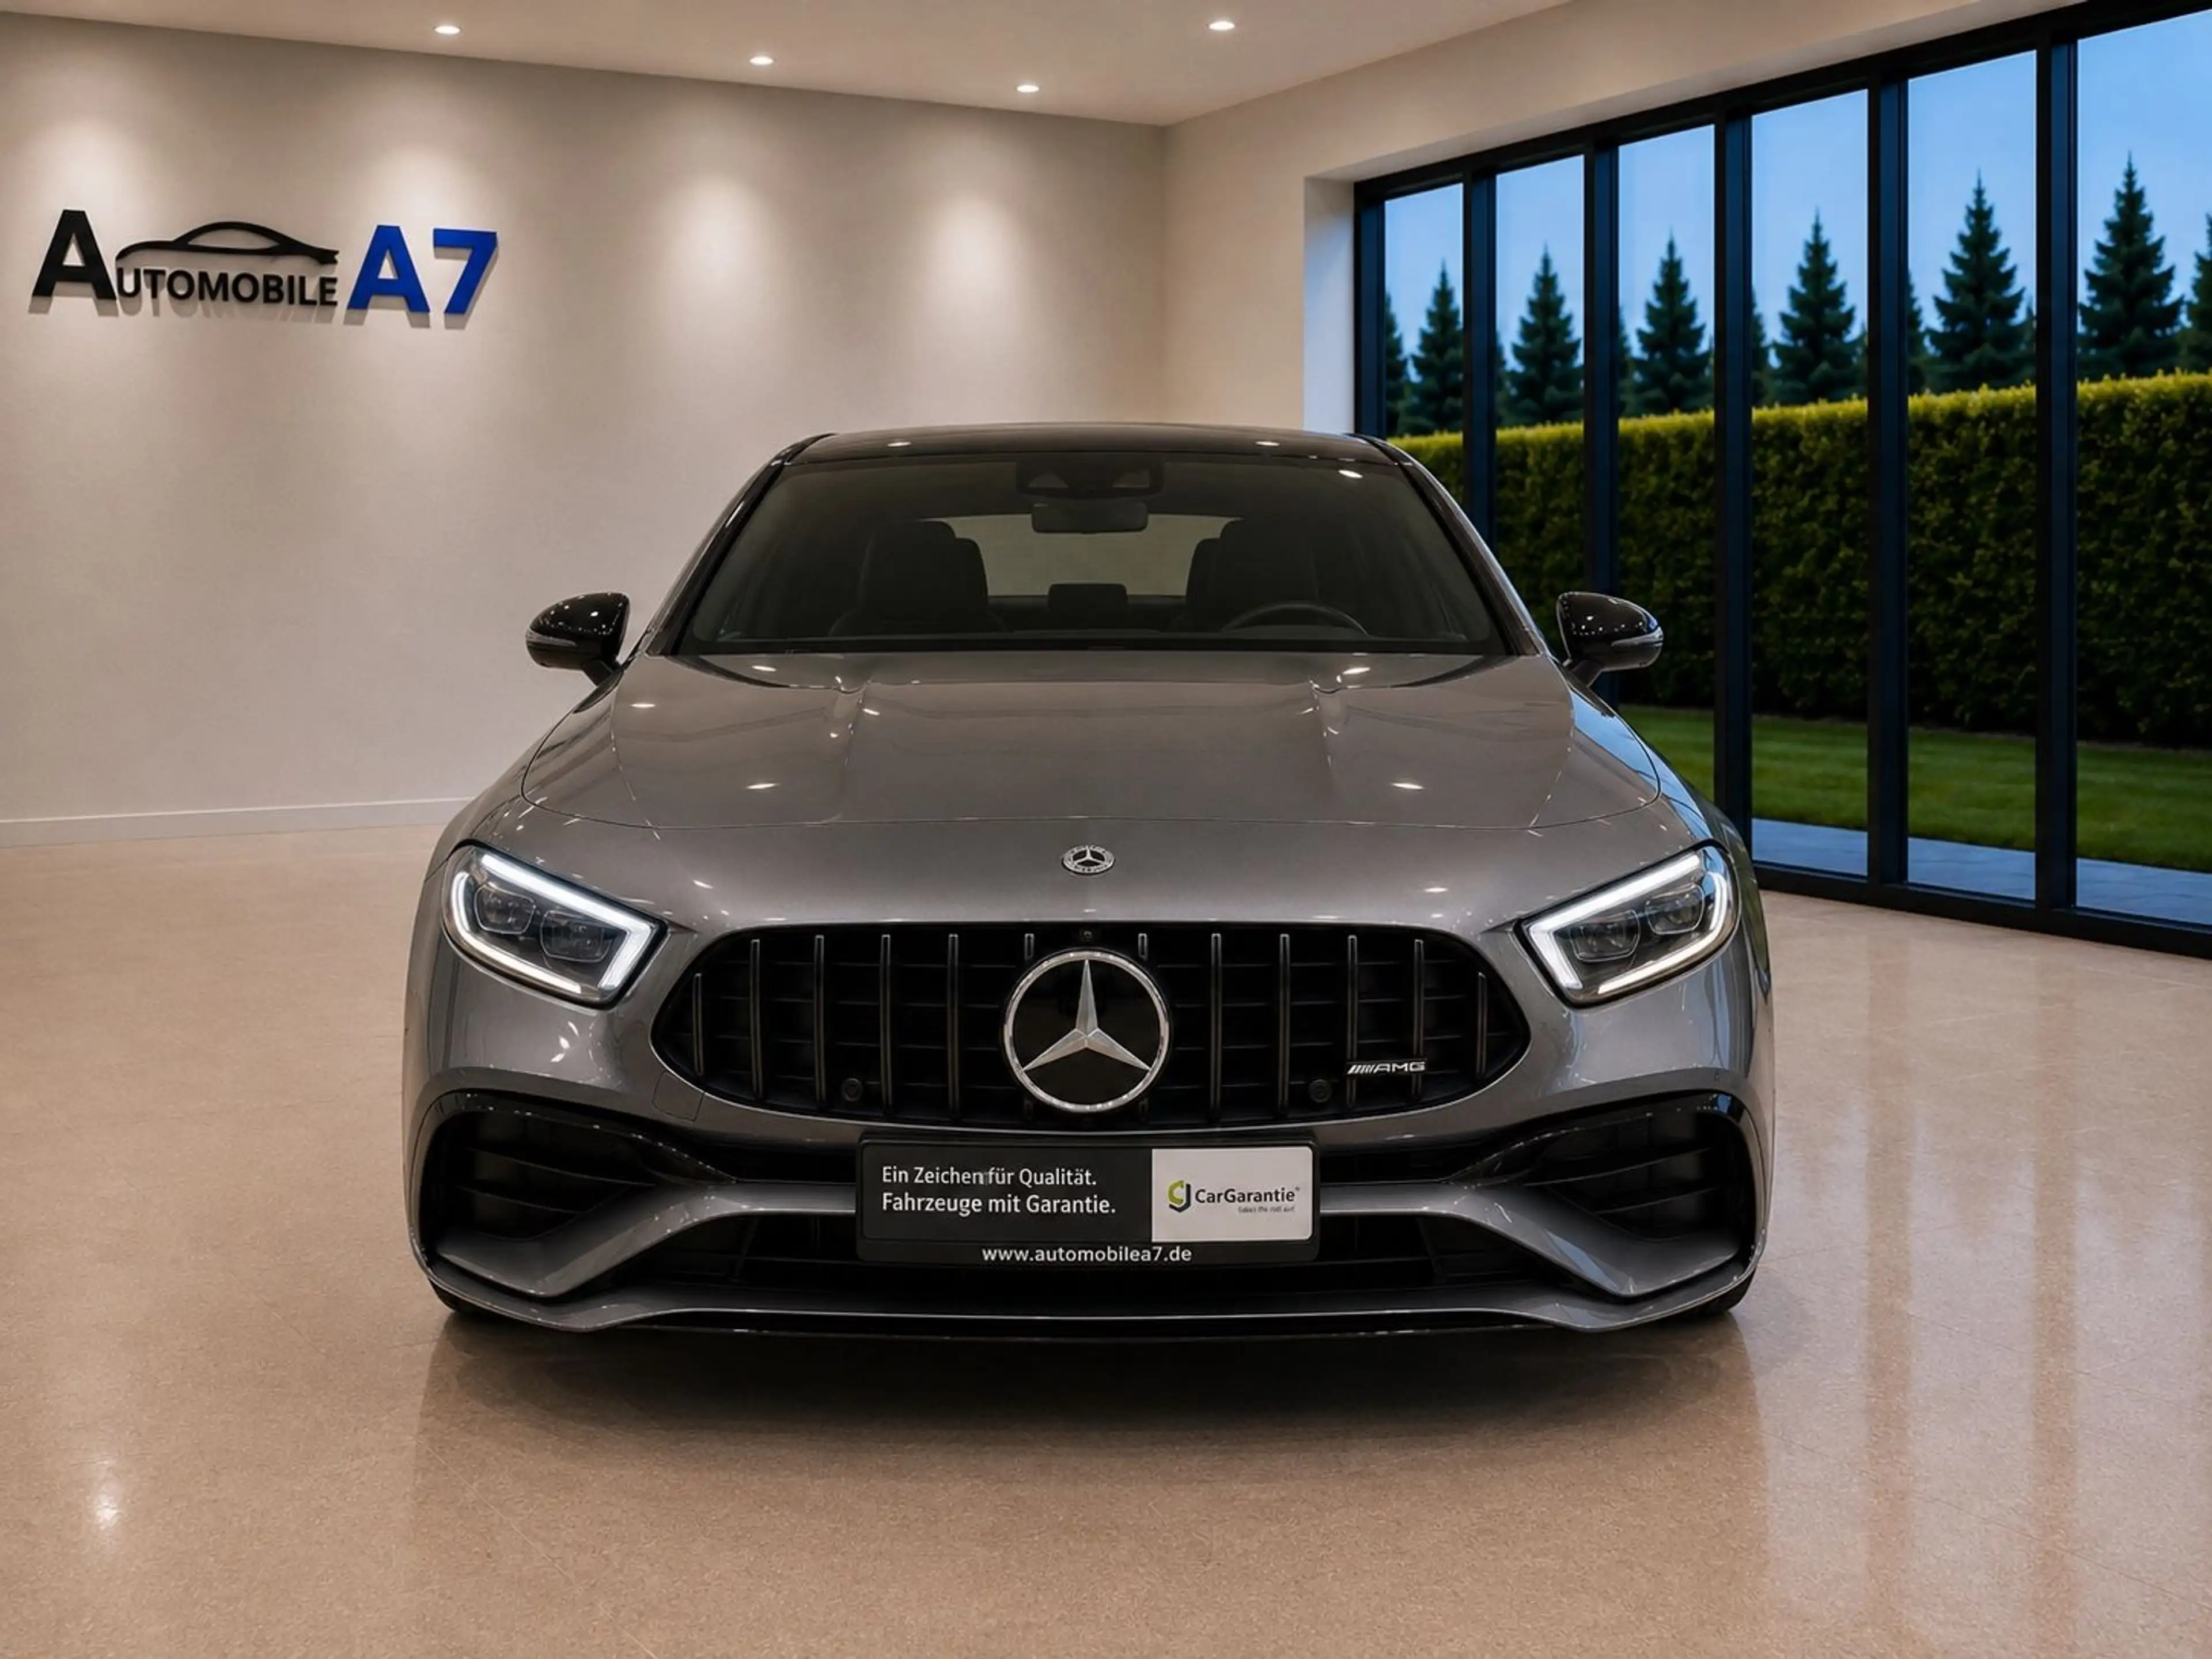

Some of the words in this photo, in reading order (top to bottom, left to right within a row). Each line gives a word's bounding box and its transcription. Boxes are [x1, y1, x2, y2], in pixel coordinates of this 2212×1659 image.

[346, 224, 498, 315] A7
[1373, 1061, 1426, 1074] AMG
[882, 1166, 908, 1183] Ein
[914, 1166, 984, 1185] Zeichen
[987, 1167, 1014, 1185] für
[1018, 1168, 1097, 1188] Qualität.
[882, 1192, 982, 1217] Fahrzeuge
[988, 1194, 1021, 1213] mit
[1026, 1195, 1116, 1213] Garantie.
[982, 1245, 1192, 1263] www.automobilea7.de
